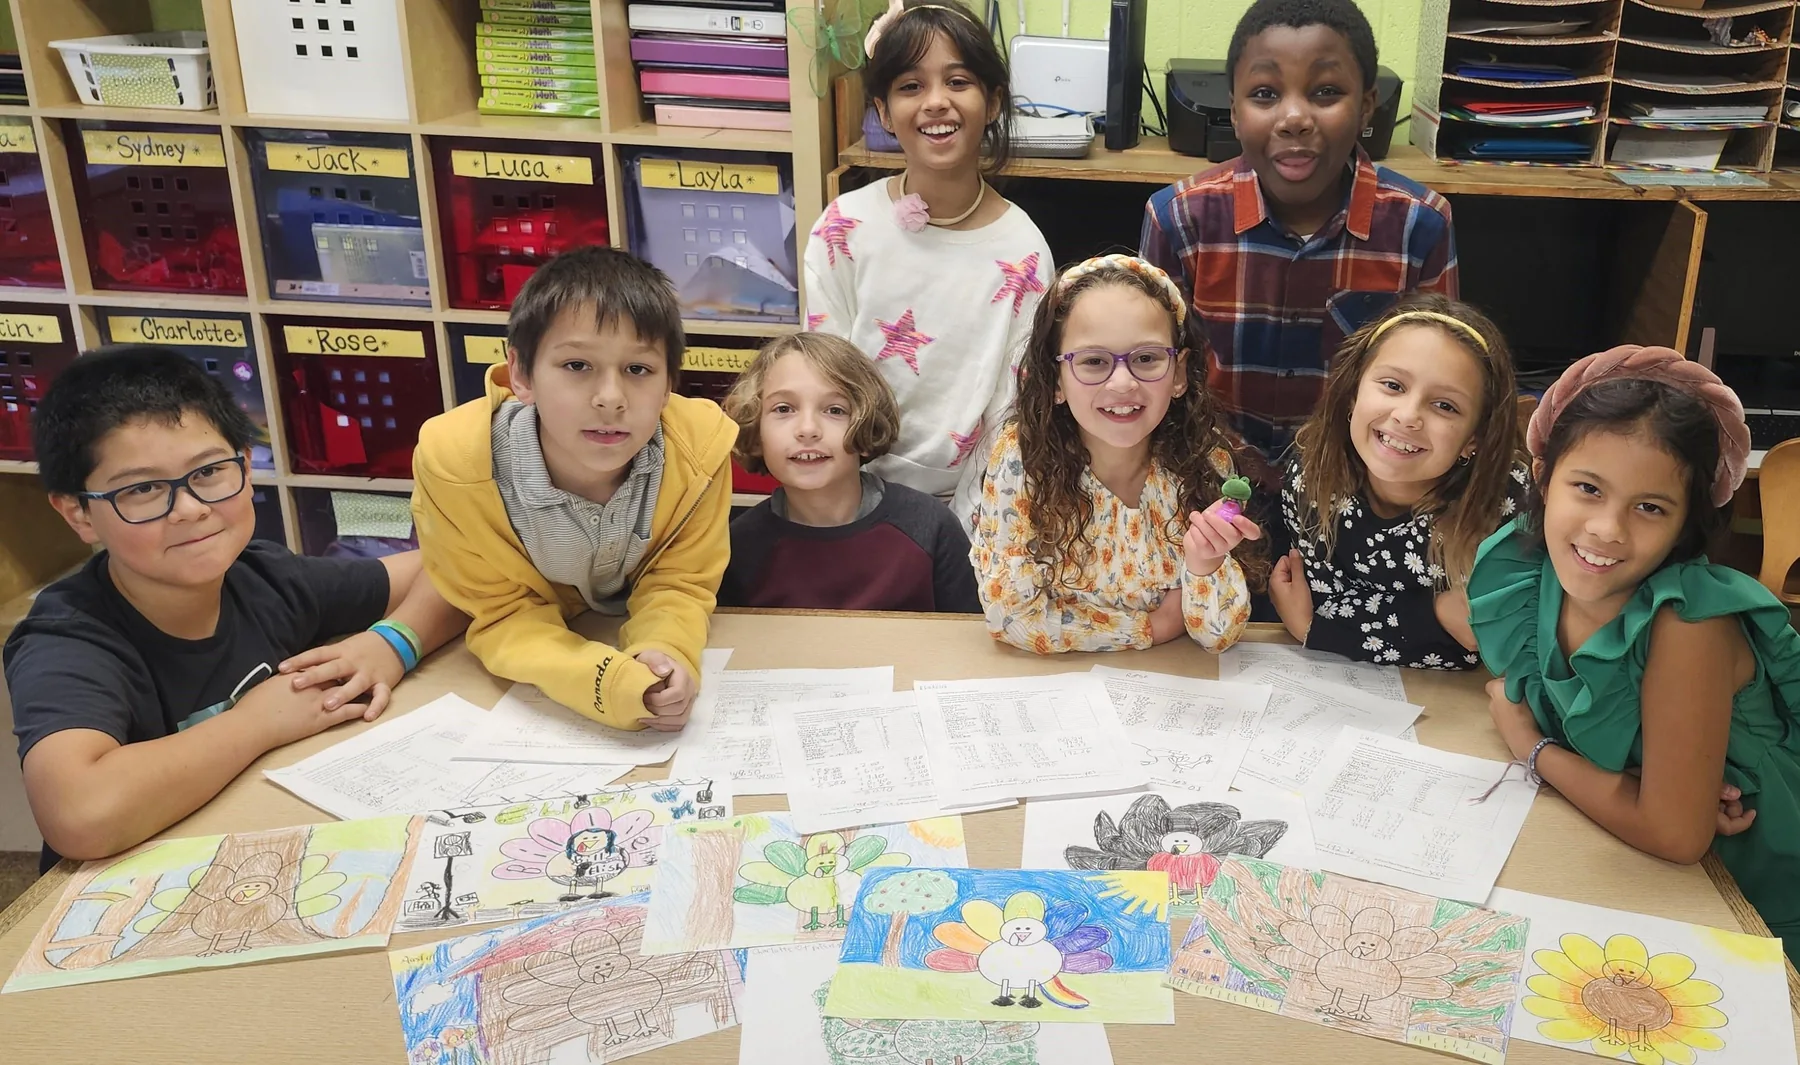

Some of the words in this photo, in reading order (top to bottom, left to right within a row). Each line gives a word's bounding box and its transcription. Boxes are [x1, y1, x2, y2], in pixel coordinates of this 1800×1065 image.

[528, 27, 552, 36] Math
[529, 53, 552, 61] Math
[535, 90, 558, 99] Math
[117, 135, 185, 163] Sydney
[306, 146, 367, 173] Jack
[483, 152, 549, 179] Luca
[677, 161, 743, 190] Layla
[140, 317, 237, 342] Charlotte
[316, 329, 379, 352] Rose
[594, 656, 613, 714] Canada
